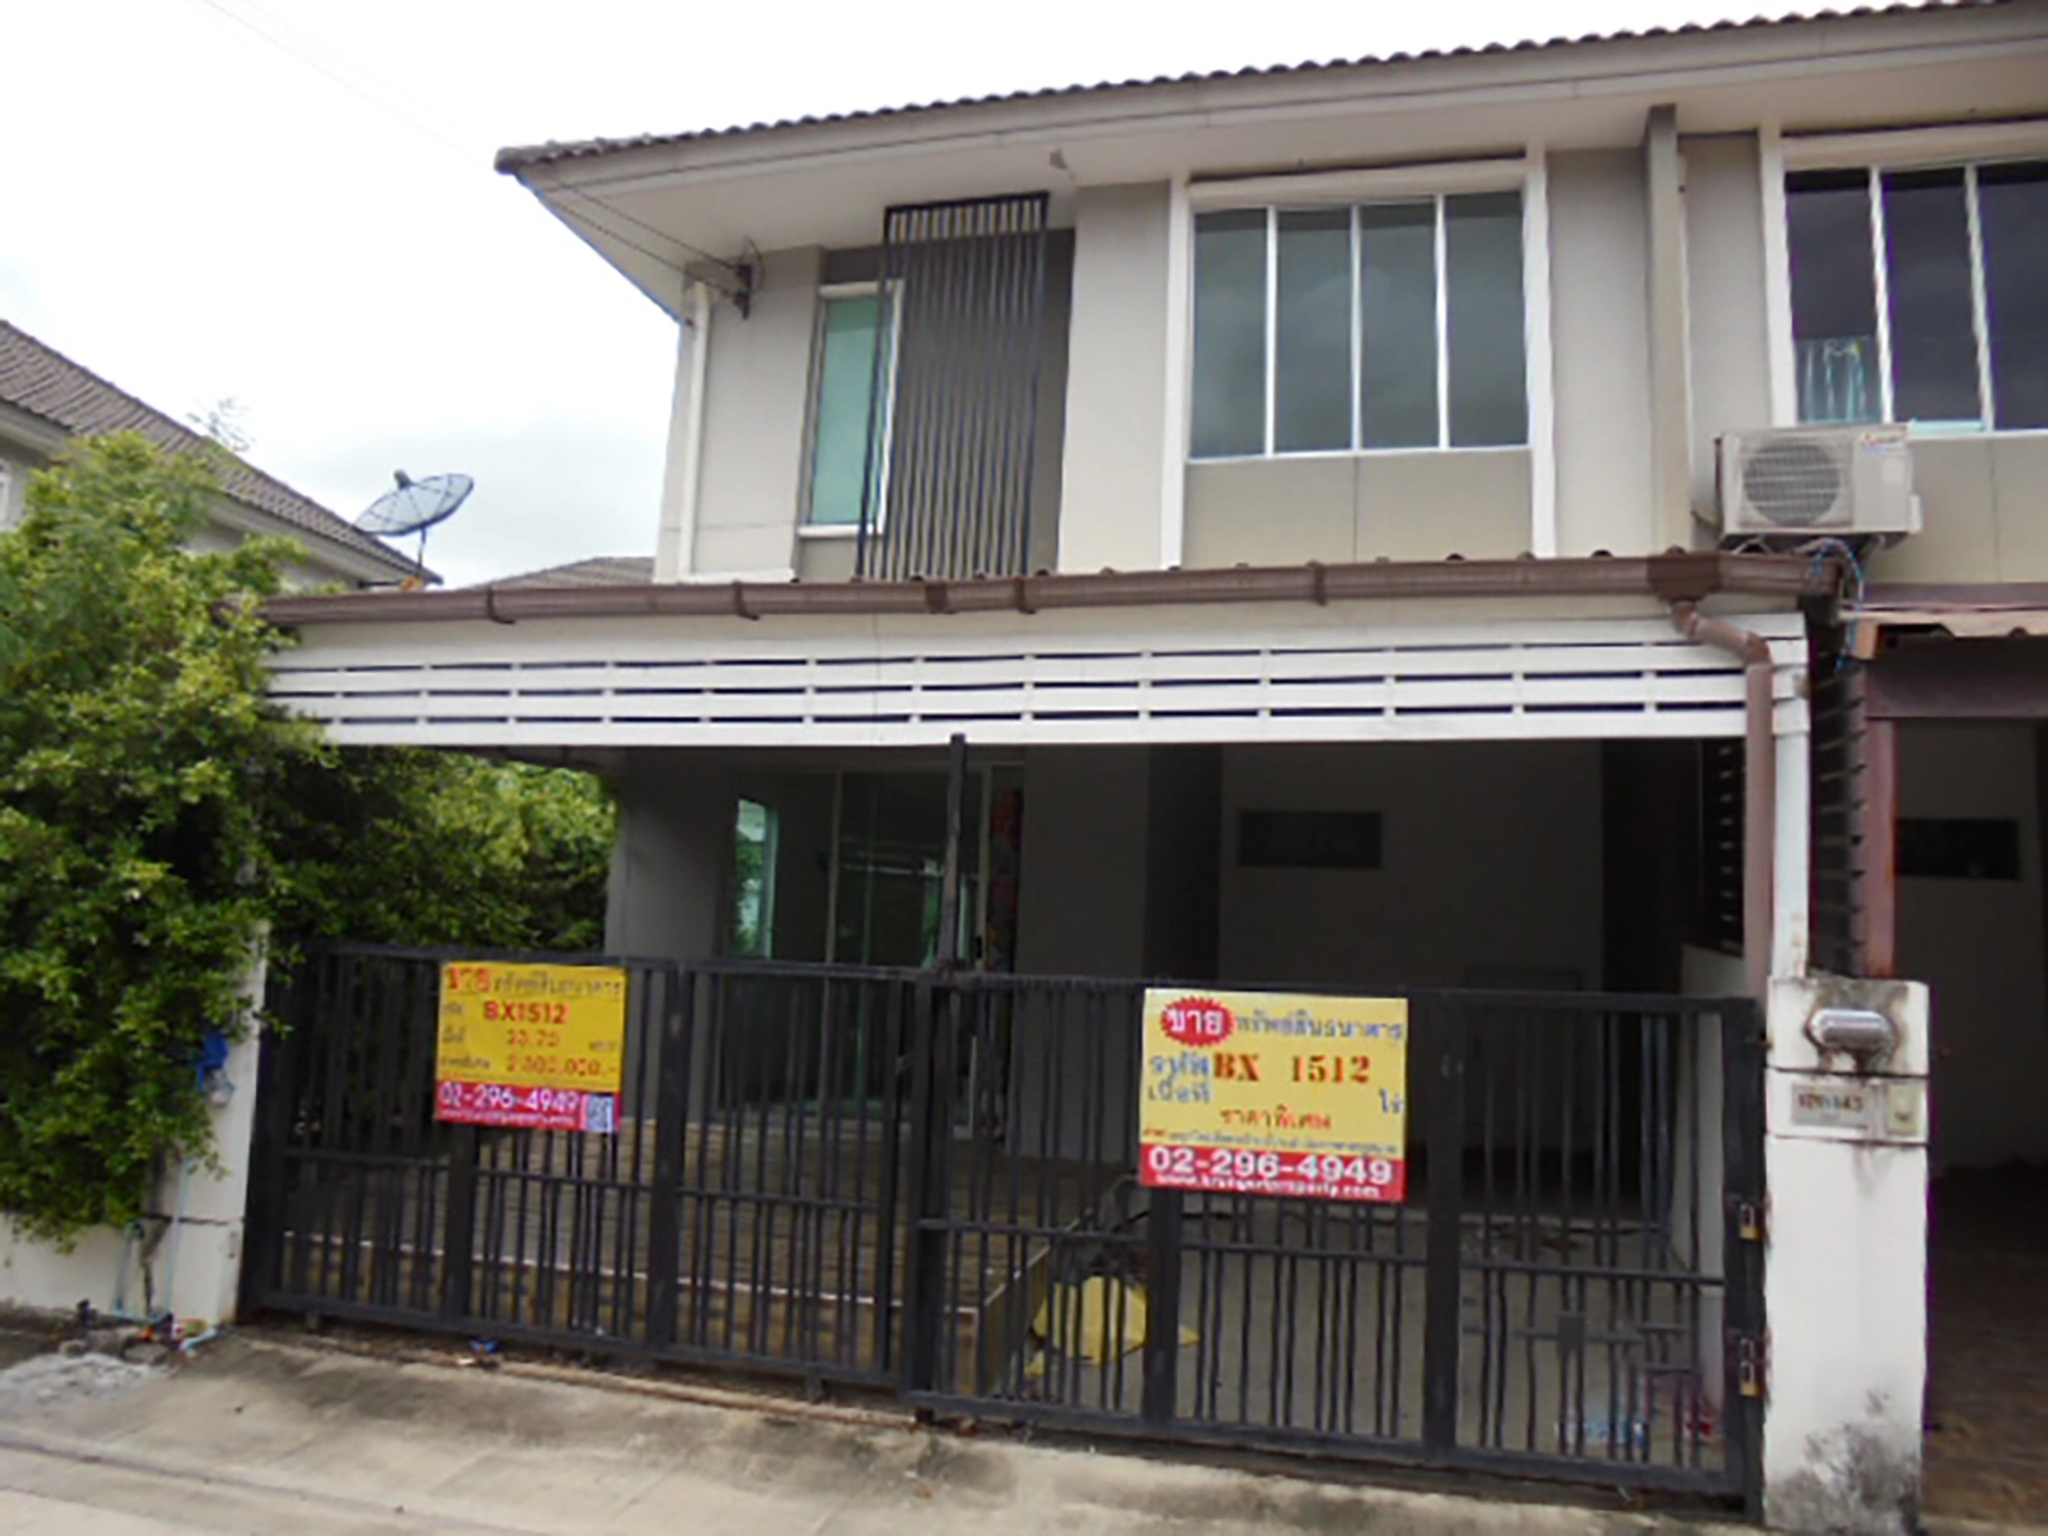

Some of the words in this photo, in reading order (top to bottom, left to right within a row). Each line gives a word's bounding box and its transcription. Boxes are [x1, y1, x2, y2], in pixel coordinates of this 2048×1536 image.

[484, 1001, 570, 1024] BX1512
[1165, 1010, 1223, 1035] ขาย
[1213, 1053, 1260, 1082] BX
[1291, 1055, 1370, 1085] 1512
[1149, 1147, 1393, 1185] 02-296-4949
